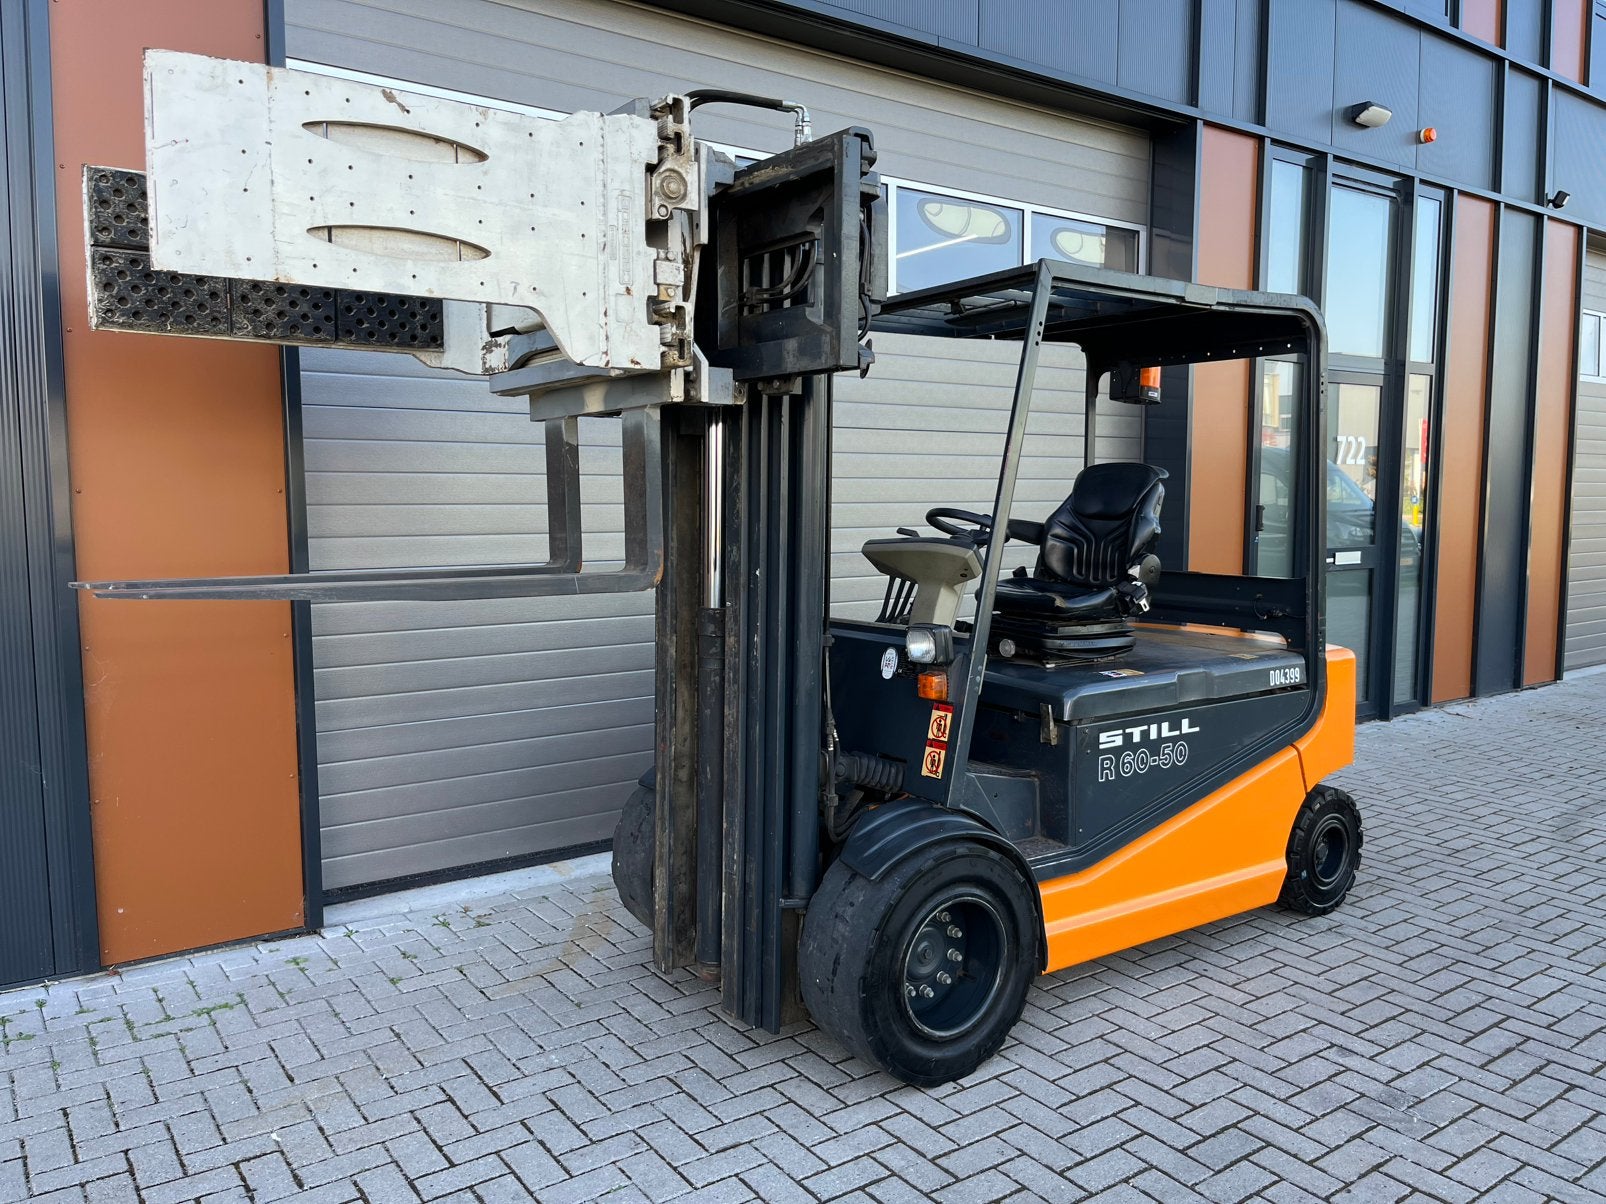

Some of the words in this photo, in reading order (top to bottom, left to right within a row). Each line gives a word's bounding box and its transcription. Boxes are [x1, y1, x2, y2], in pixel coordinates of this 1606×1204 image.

[1336, 435, 1366, 465] 722
[1098, 718, 1200, 749] STILL
[1098, 754, 1115, 782] R
[1119, 741, 1189, 777] 60-50
